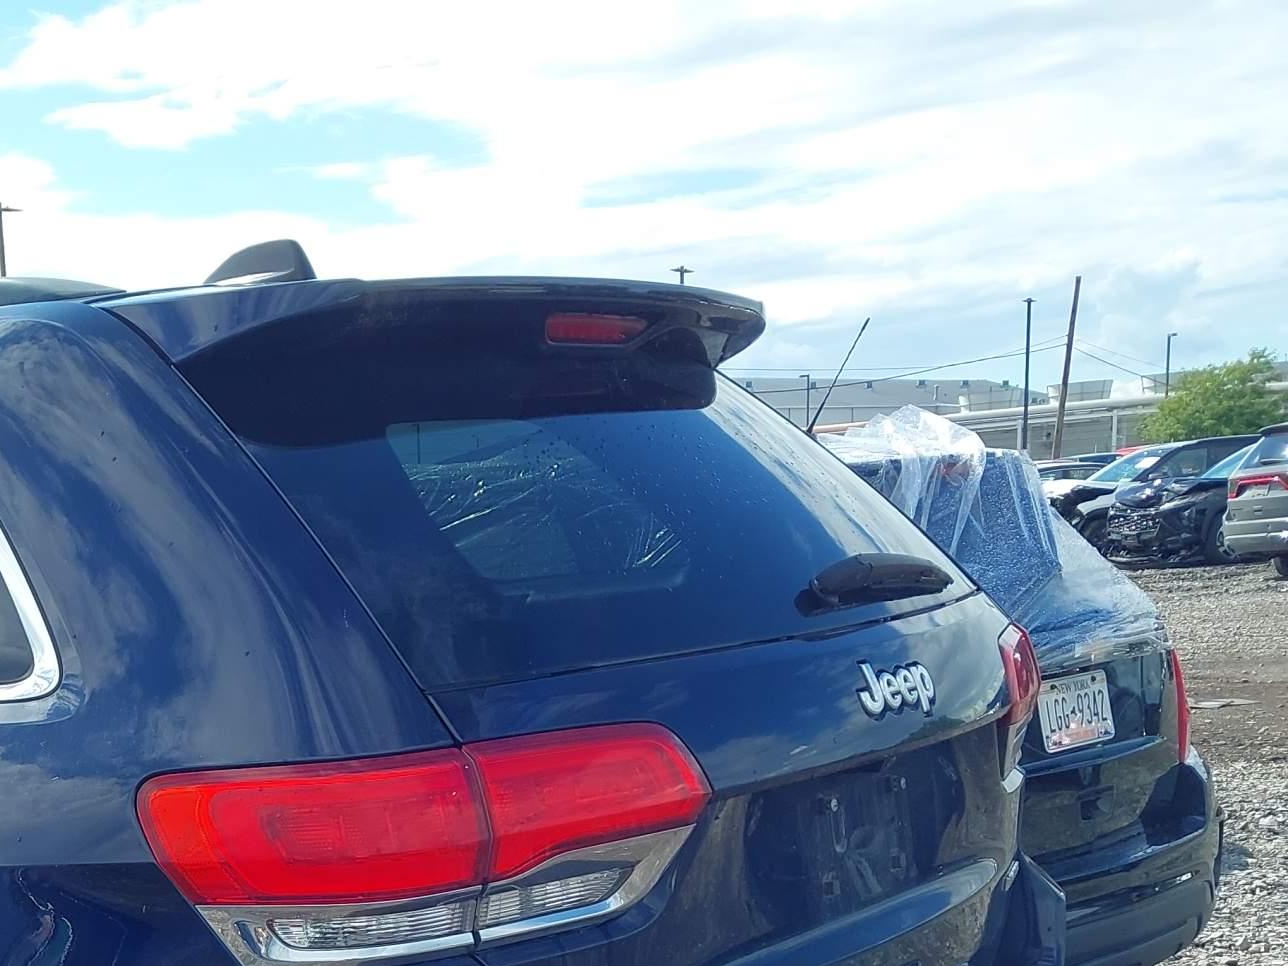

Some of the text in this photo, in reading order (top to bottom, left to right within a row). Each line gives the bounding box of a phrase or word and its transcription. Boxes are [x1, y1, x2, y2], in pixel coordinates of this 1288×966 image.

[856, 659, 936, 721] Jeep
[1055, 678, 1092, 695] NEW YORK
